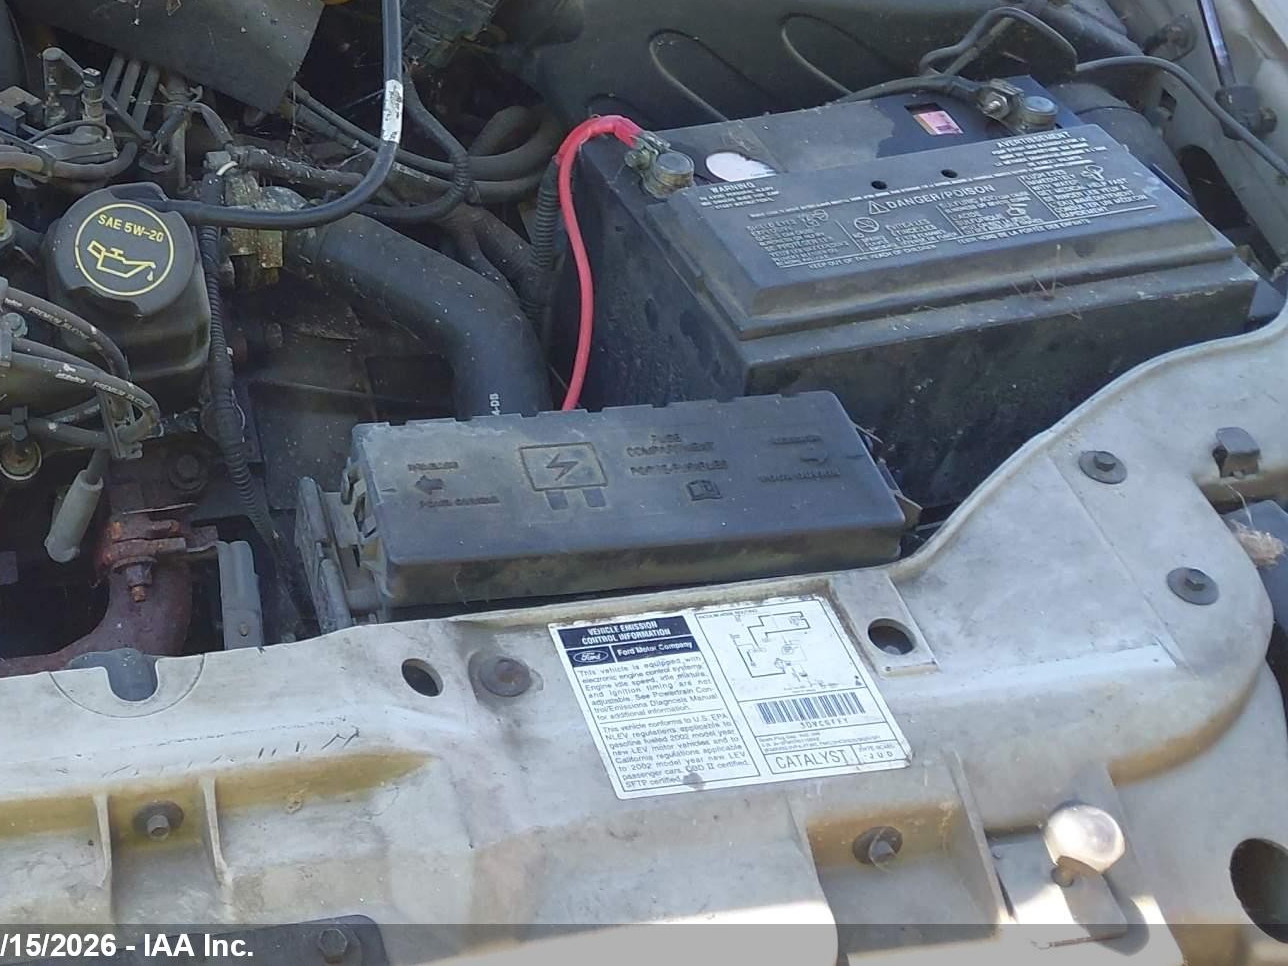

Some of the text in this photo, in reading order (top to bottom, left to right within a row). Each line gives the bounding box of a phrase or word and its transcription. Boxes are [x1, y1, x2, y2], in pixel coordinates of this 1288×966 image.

[1021, 172, 1046, 180] FLUSH
[709, 181, 755, 194] WARNING
[884, 184, 995, 208] DANGER/POISON
[98, 213, 165, 243] SAE 5W-20
[587, 621, 657, 635] VEHICLE EMISSION
[581, 628, 671, 644] CONTROL INFORMATION
[617, 640, 694, 656] Ford Motor Company
[579, 651, 601, 661] Ford
[599, 665, 628, 673] vehicle
[643, 658, 682, 668] equipped
[582, 674, 617, 683] electronic
[618, 671, 644, 679] engine
[645, 667, 671, 675] control
[585, 683, 612, 691] Engine
[609, 686, 641, 695] ignition
[646, 682, 673, 691] timing
[652, 687, 694, 697] Powertrain
[594, 693, 718, 712] trol/Emissions Diagnosis Manual
[609, 709, 646, 718] additional
[605, 732, 629, 740] NLEV
[631, 726, 676, 737] regulations
[678, 721, 720, 732] applicable
[620, 722, 646, 730] vehicle
[647, 718, 682, 727] conforms
[608, 739, 642, 748] gasoline
[691, 730, 716, 738] model
[651, 743, 674, 751] motor
[677, 739, 709, 748] vehicles
[615, 744, 742, 763] California regulations applicable
[774, 749, 849, 769] CATALYST
[630, 762, 652, 770] 2002
[655, 758, 681, 767] model
[622, 769, 662, 780] passenger
[685, 764, 705, 772] OBD
[625, 779, 648, 787] SFTP
